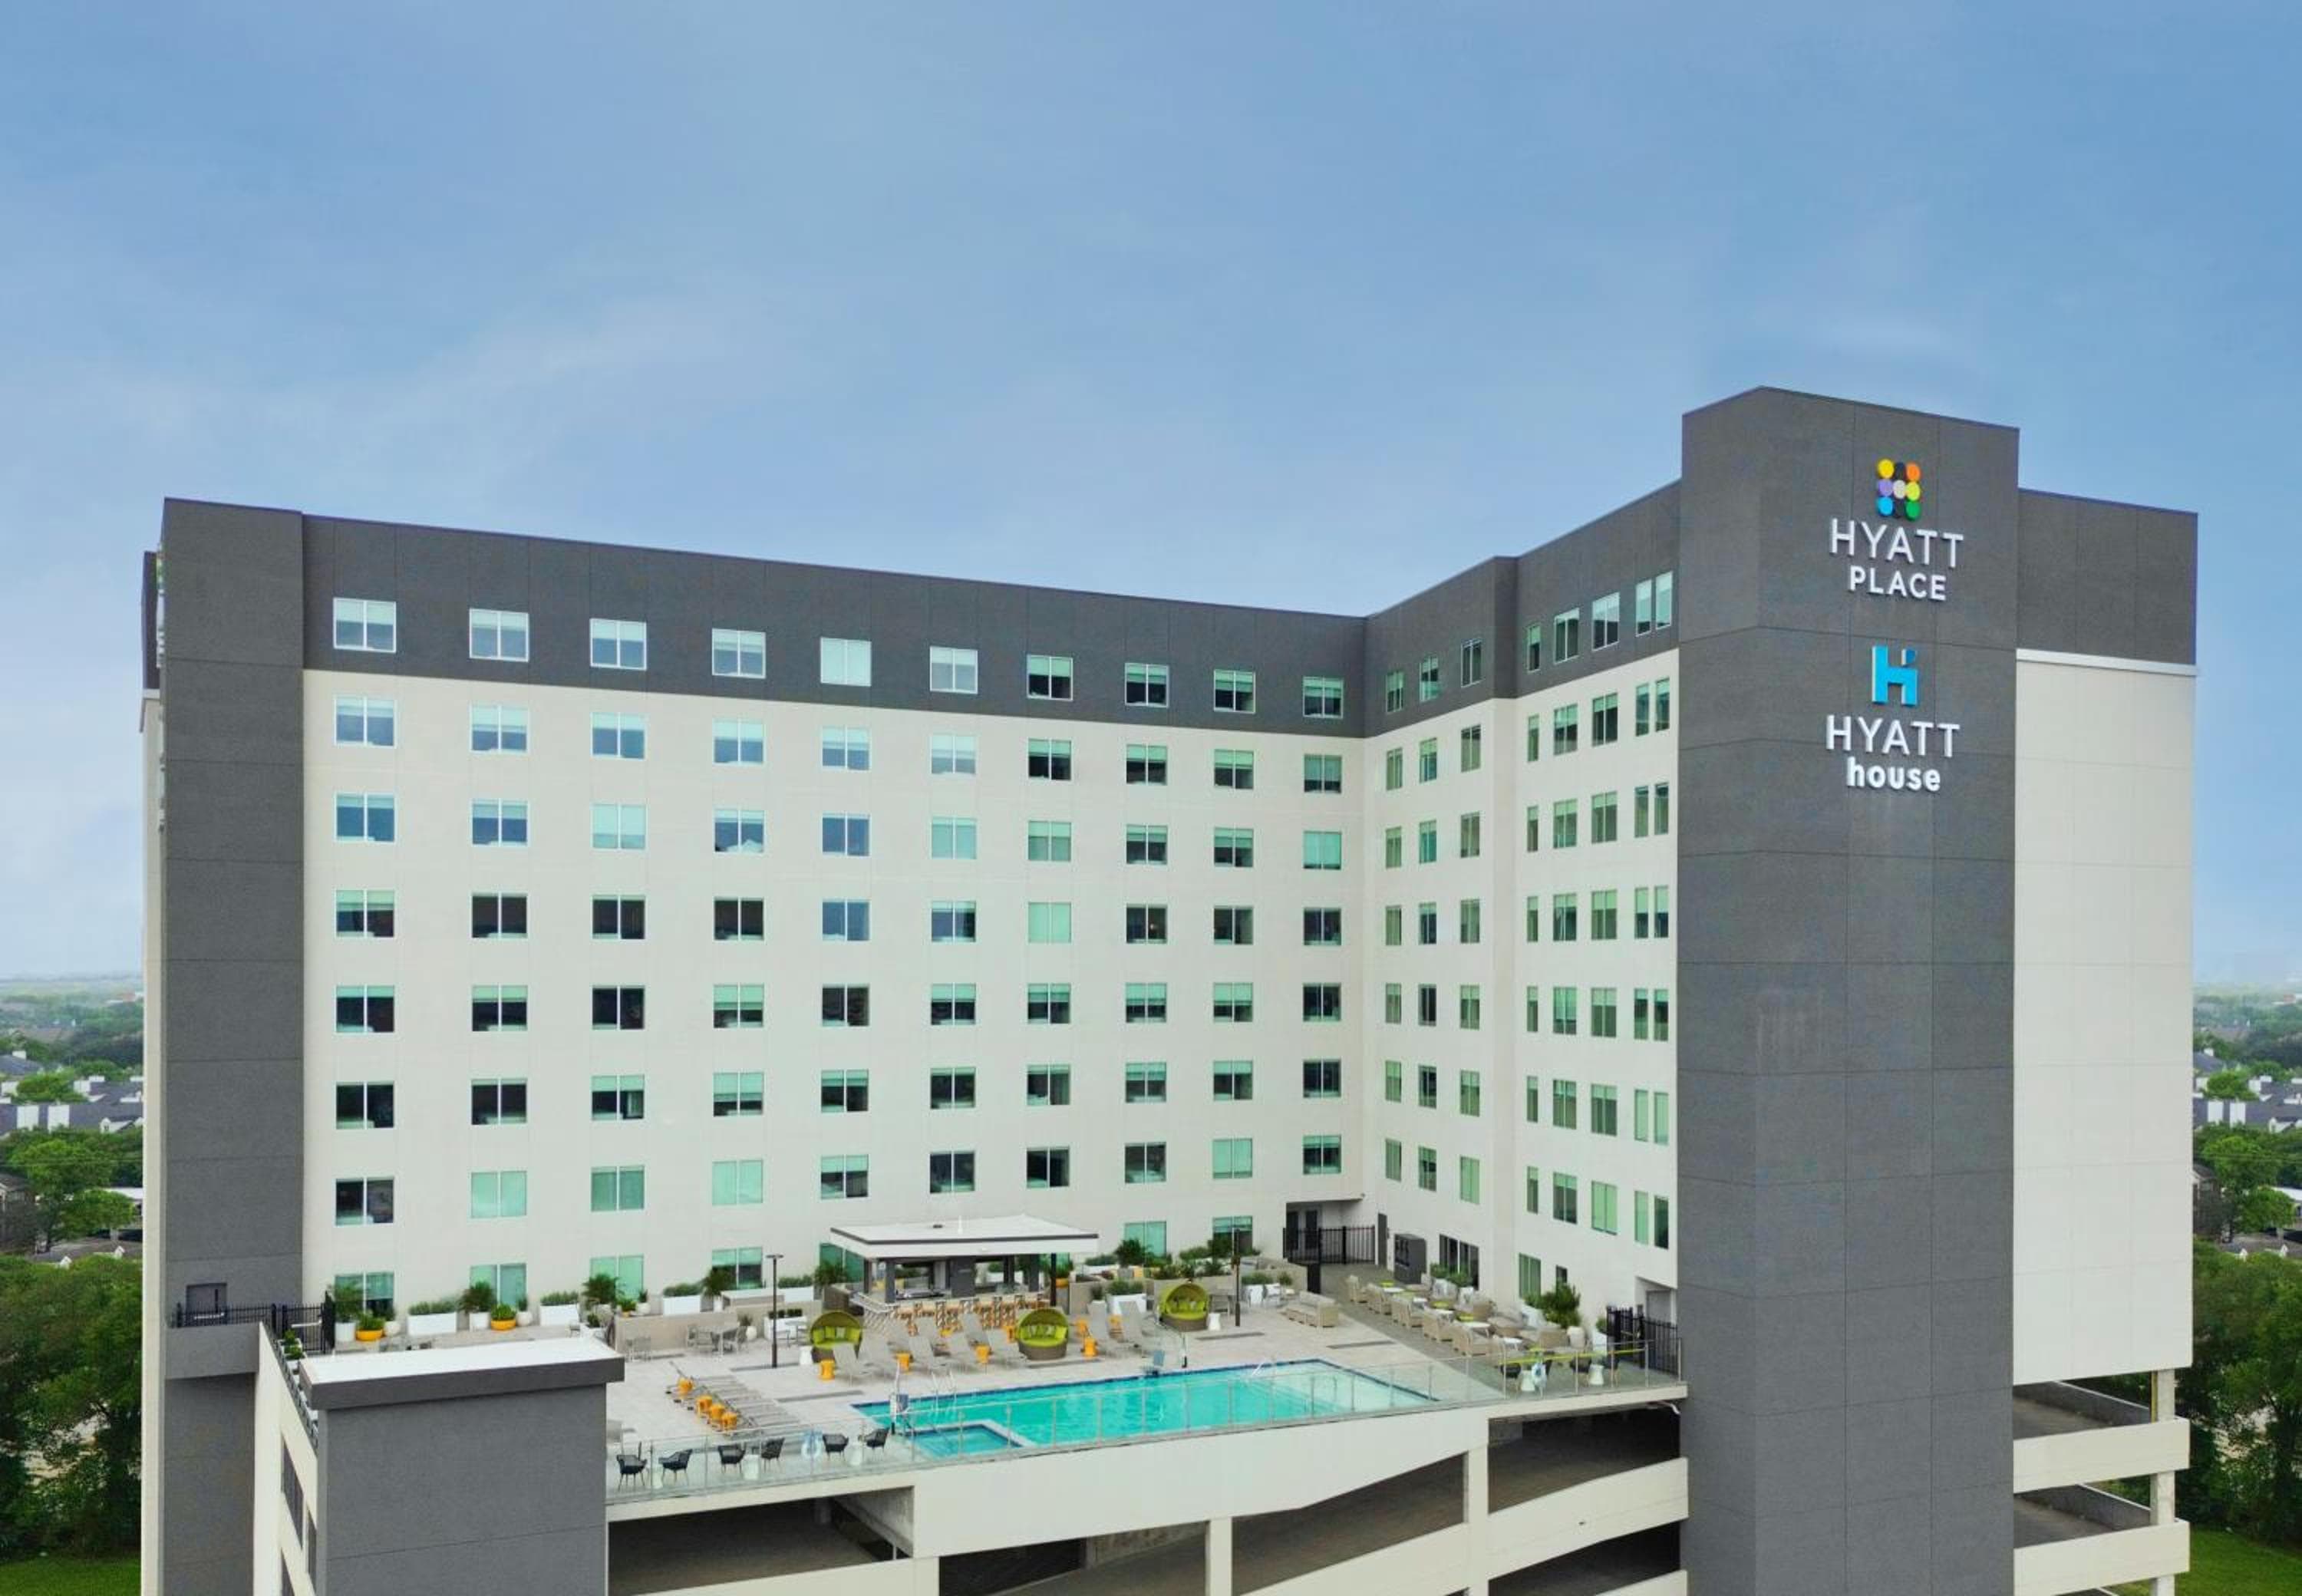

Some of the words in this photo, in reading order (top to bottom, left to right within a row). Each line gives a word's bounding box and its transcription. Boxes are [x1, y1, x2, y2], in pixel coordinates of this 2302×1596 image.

[1830, 517, 1964, 569] HYATT
[1849, 565, 1947, 602] PLACE
[1825, 714, 1961, 759] HYATT
[1845, 756, 1941, 793] house
